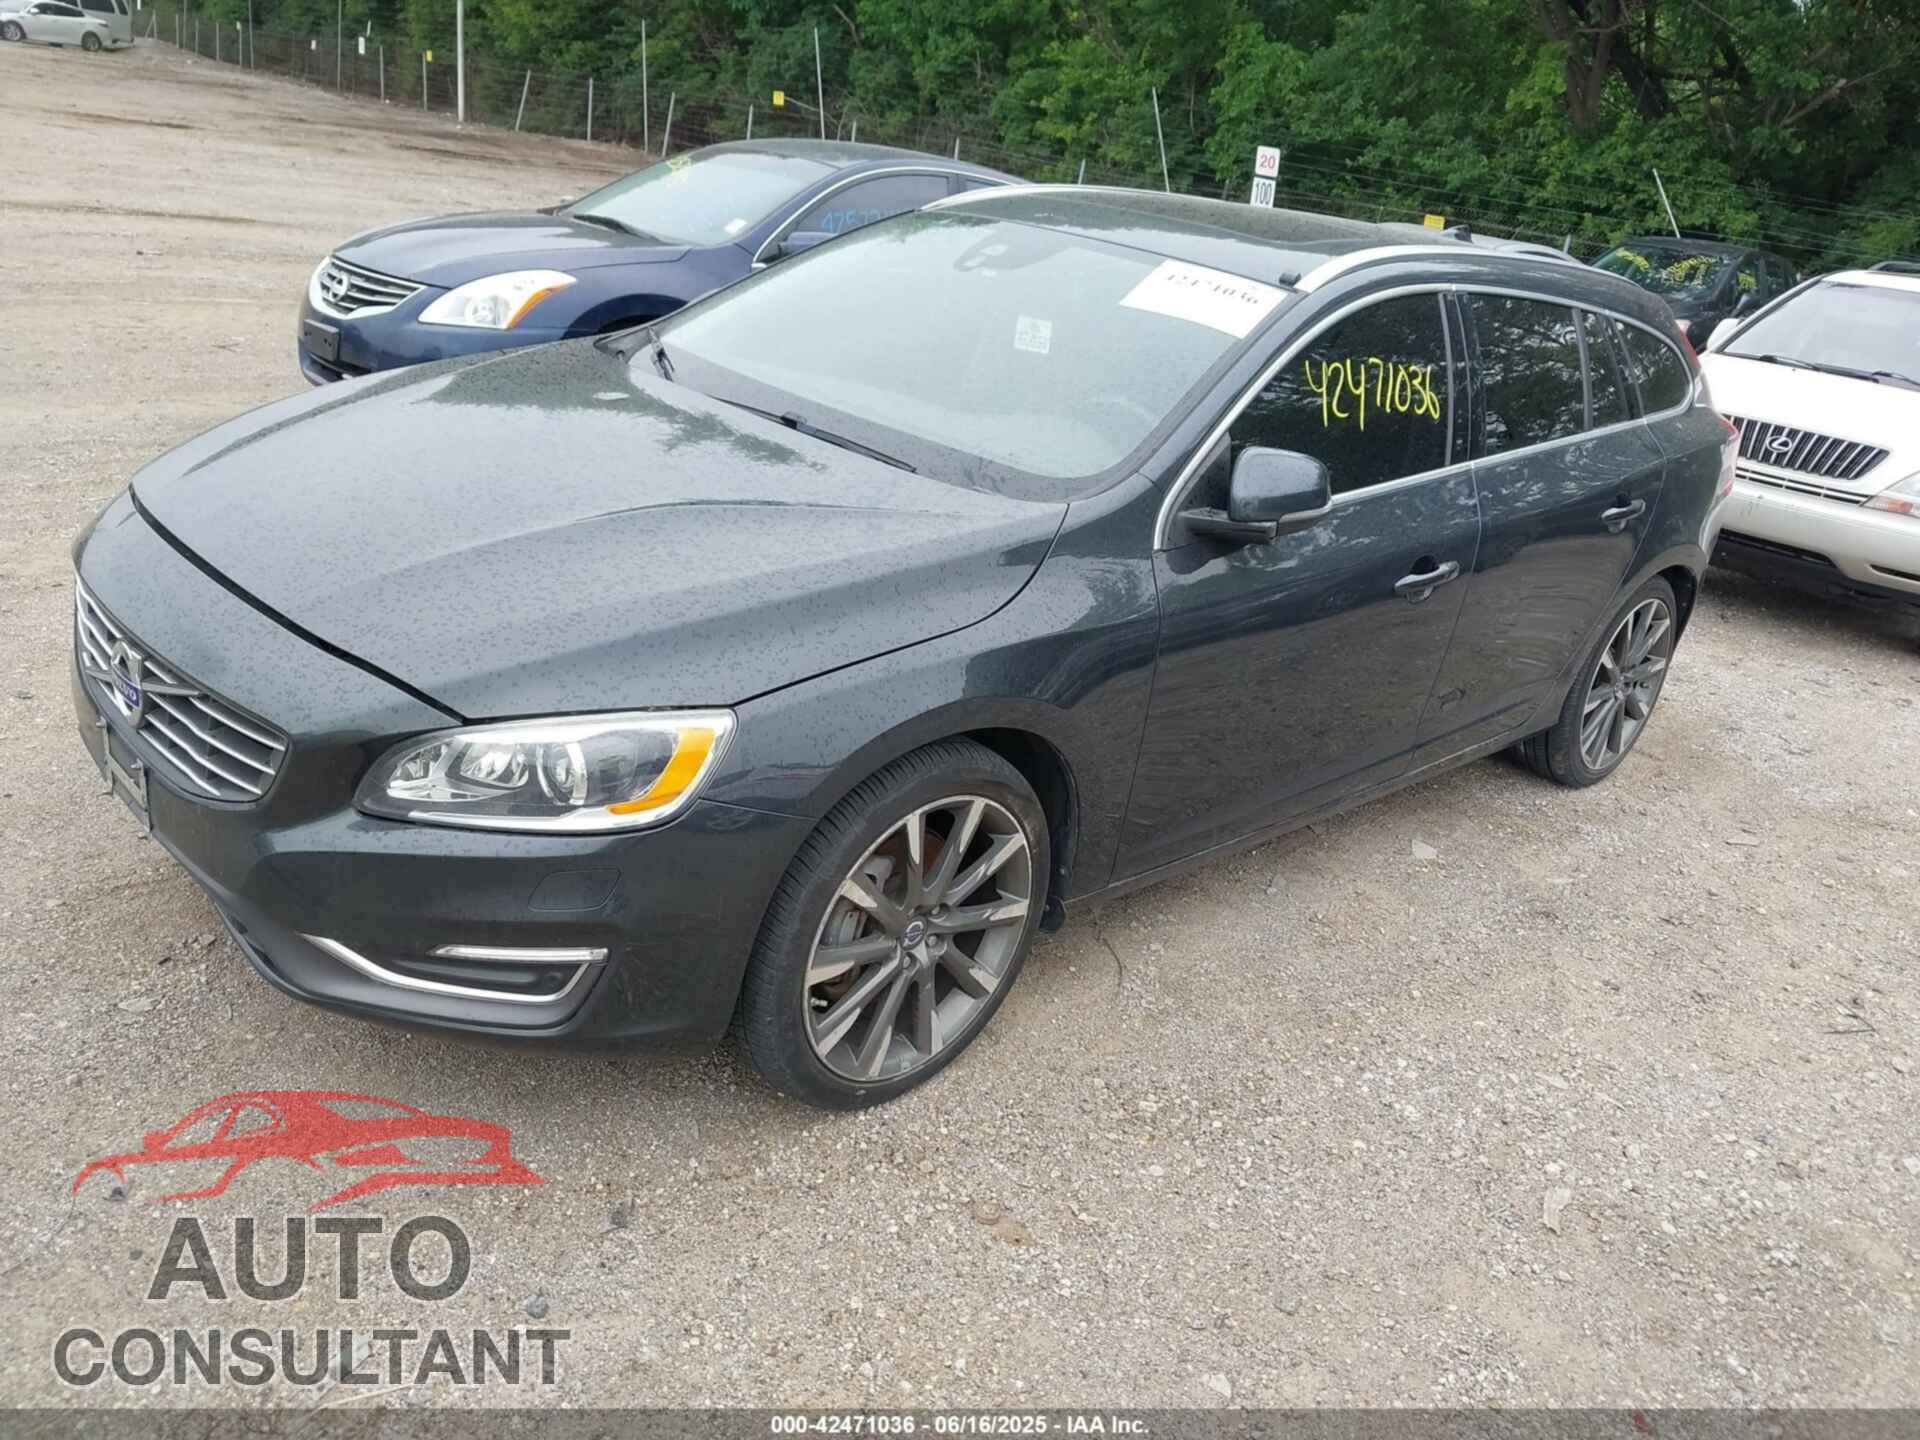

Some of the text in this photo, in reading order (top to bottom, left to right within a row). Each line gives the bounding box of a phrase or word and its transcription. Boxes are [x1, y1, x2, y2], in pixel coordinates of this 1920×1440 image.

[1259, 154, 1276, 169] 20
[1254, 182, 1272, 206] 100
[1305, 357, 1440, 432] 42471036
